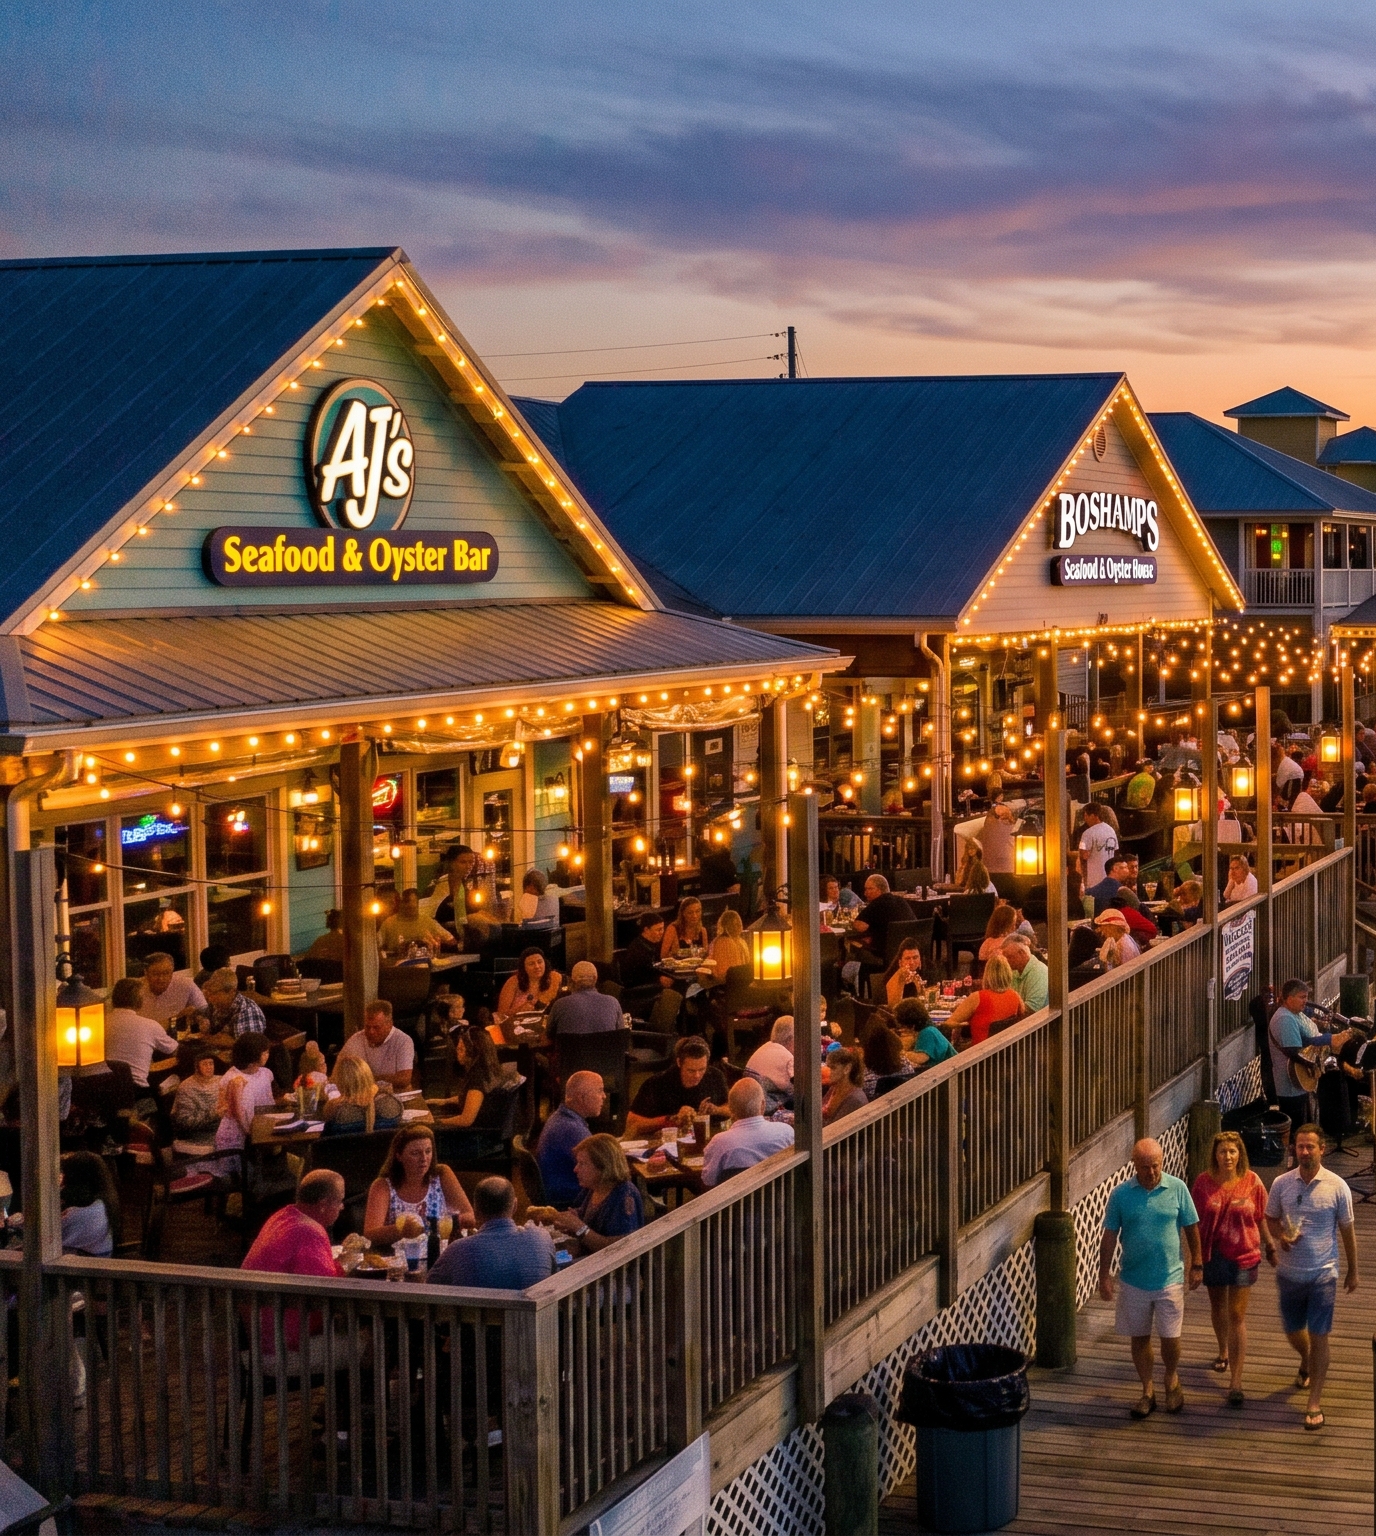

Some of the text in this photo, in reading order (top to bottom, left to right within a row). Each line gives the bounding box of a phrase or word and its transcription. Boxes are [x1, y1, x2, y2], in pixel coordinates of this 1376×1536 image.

[321, 400, 414, 529] AJ's
[1058, 491, 1160, 552] BOSHAMPS
[224, 534, 491, 582] Seafood & Oyster Bar
[1064, 556, 1099, 580] Seafood
[1106, 557, 1132, 584] Oyster
